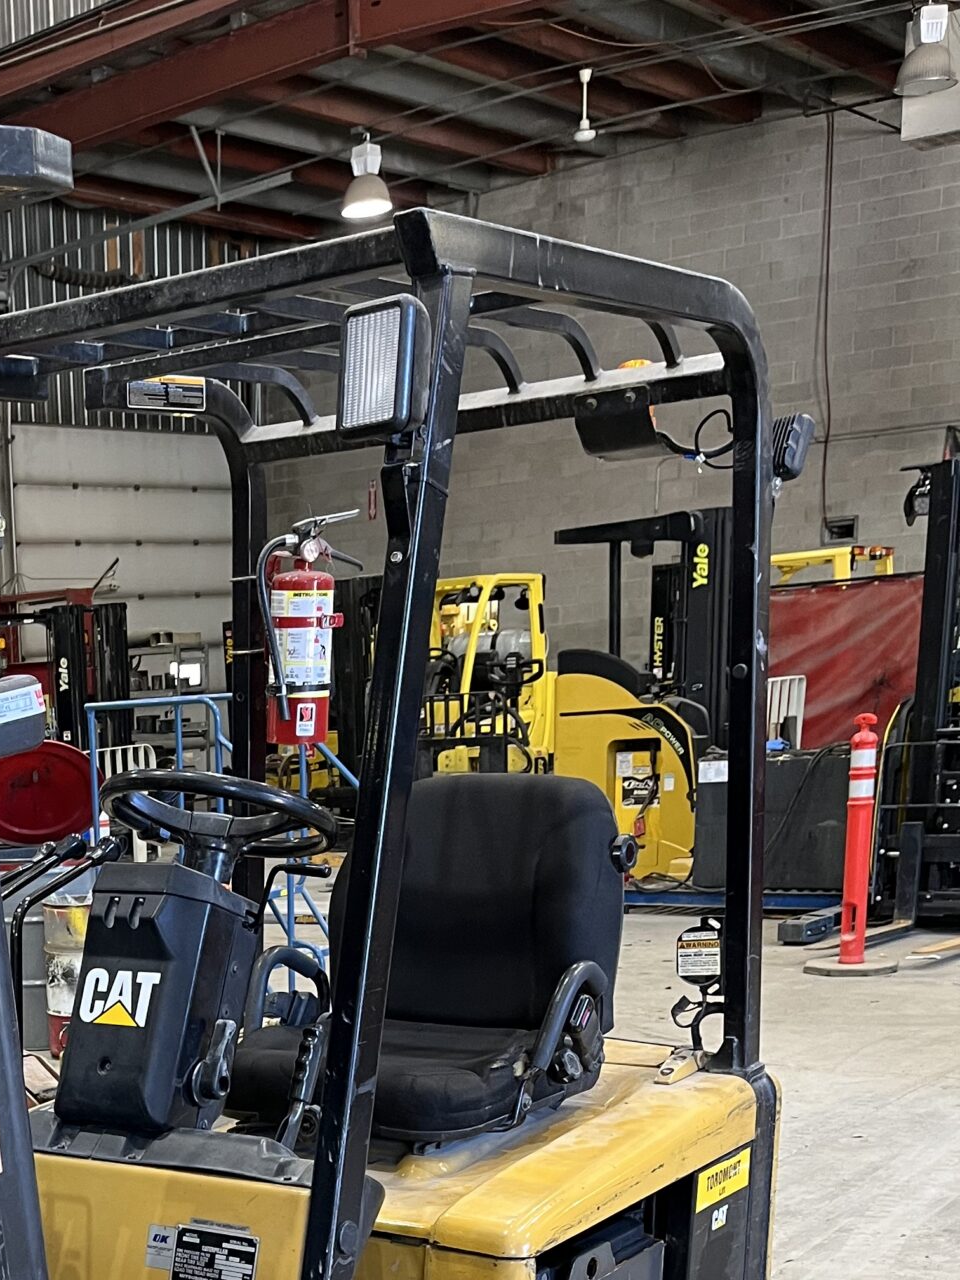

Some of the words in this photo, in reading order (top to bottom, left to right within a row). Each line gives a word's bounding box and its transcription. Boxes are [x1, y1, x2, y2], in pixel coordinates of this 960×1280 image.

[692, 543, 709, 588] Yale
[653, 616, 664, 666] HYSTER
[58, 657, 69, 692] Yale
[660, 726, 685, 756] POWER
[685, 941, 720, 949] WARNING
[79, 967, 161, 1028] CAT
[711, 1204, 729, 1231] CAT
